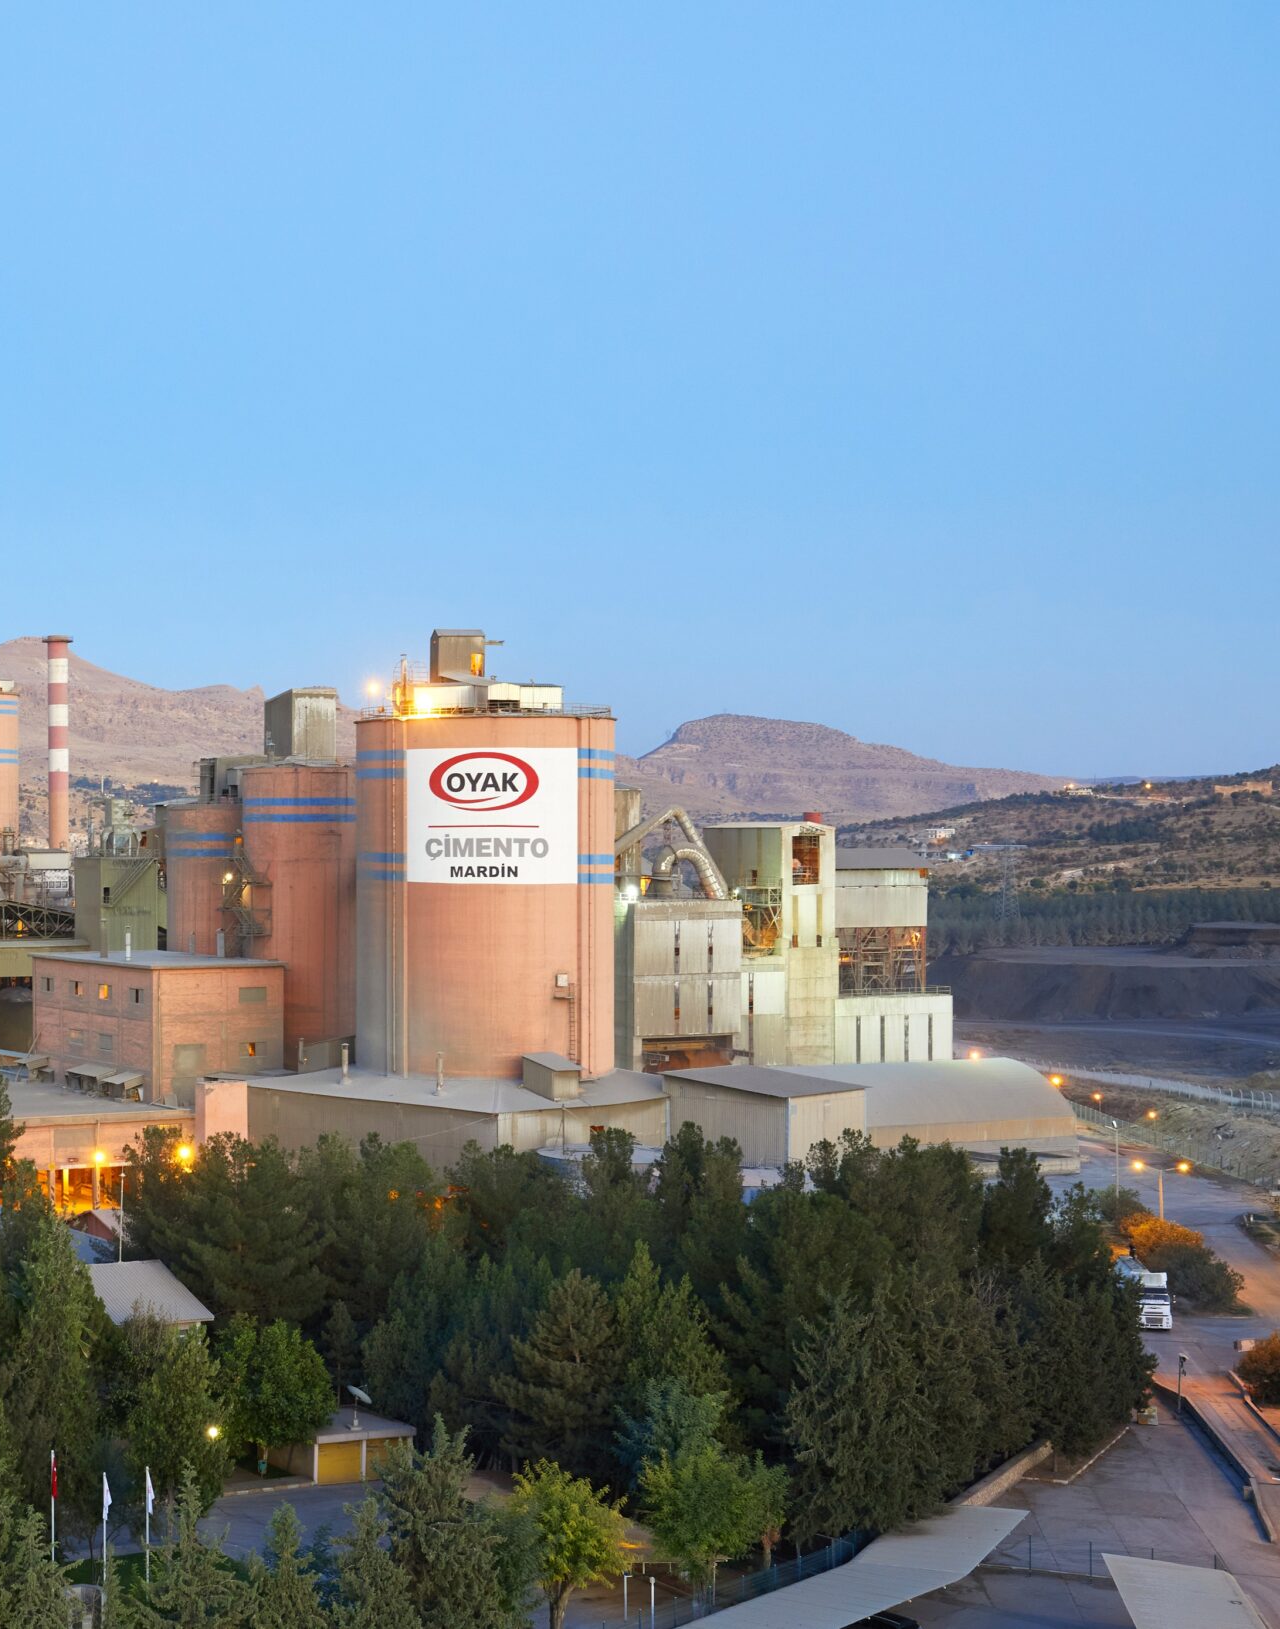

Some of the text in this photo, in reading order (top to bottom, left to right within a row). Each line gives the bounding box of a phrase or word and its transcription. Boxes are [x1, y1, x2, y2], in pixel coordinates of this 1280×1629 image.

[447, 772, 518, 792] OYAK
[425, 834, 549, 861] ÇİMENTO
[450, 863, 519, 878] MARDİN
